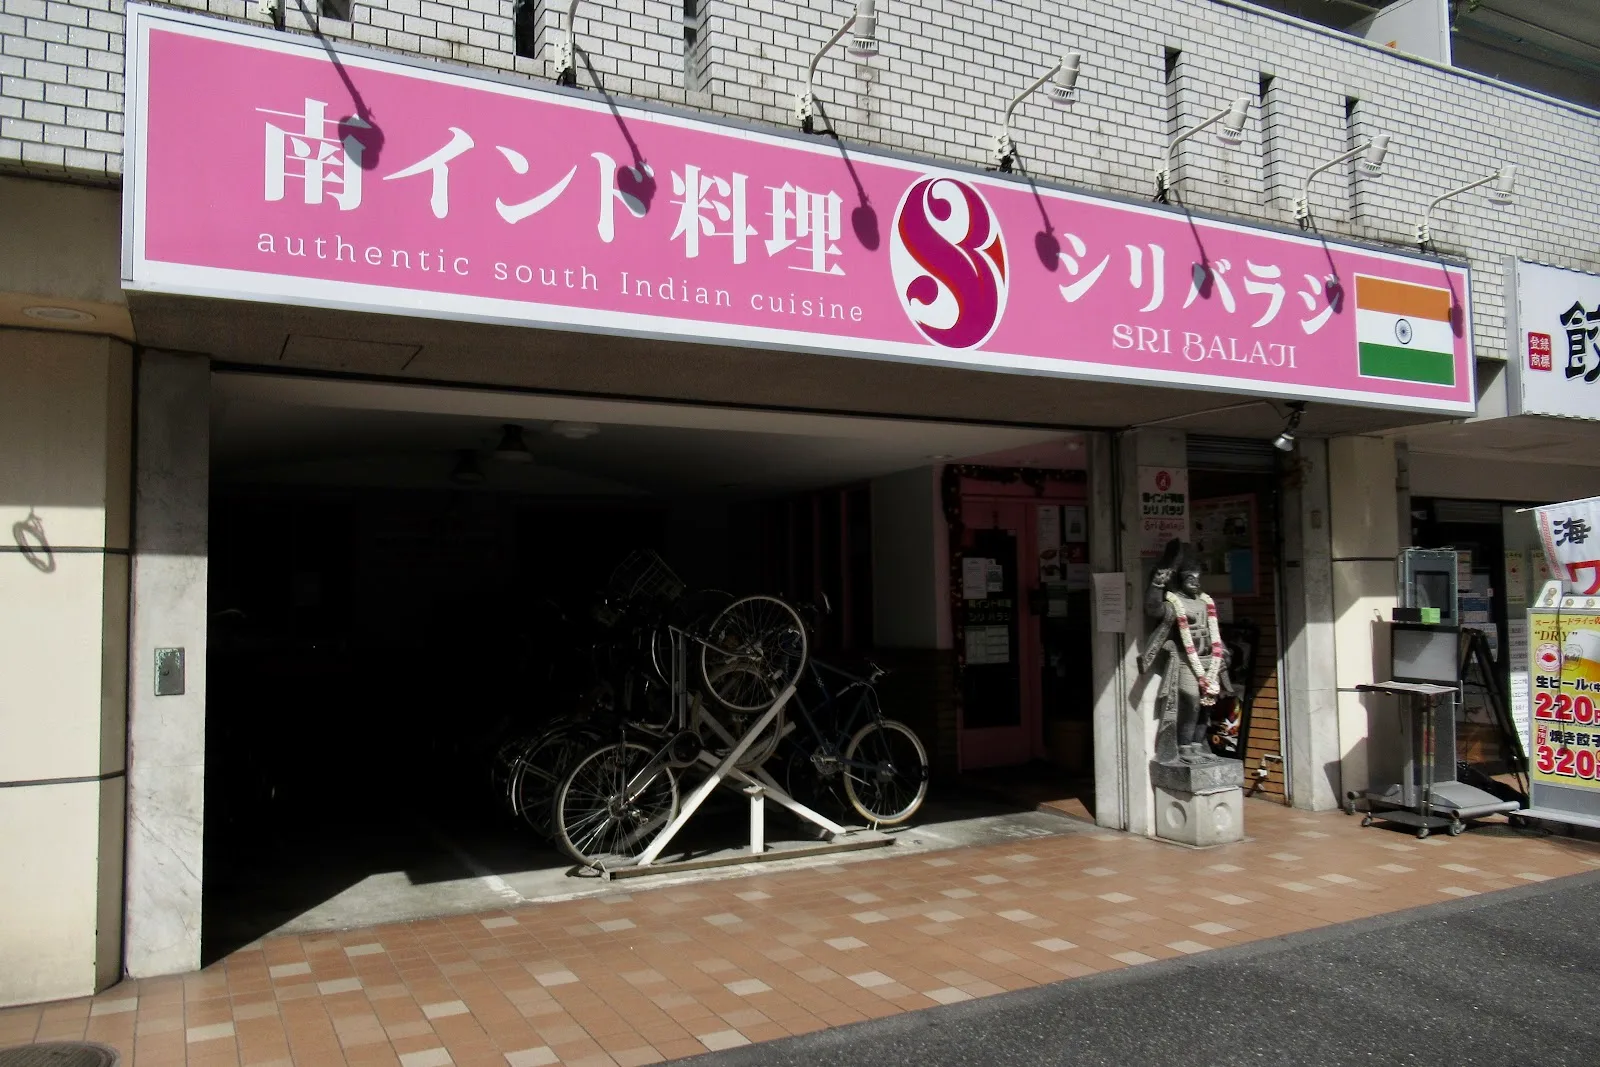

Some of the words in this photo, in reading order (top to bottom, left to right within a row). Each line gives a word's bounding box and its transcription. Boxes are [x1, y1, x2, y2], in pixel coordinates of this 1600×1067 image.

[255, 97, 846, 277] 南インド料理
[257, 231, 471, 277] authentic
[493, 258, 599, 292] south
[620, 271, 732, 307] Indian
[750, 291, 865, 323] cuisine
[1058, 232, 1342, 335] シリバラジ
[1111, 323, 1173, 355] SRI
[1182, 330, 1297, 370] BALAJI
[1553, 517, 1591, 546] 海
